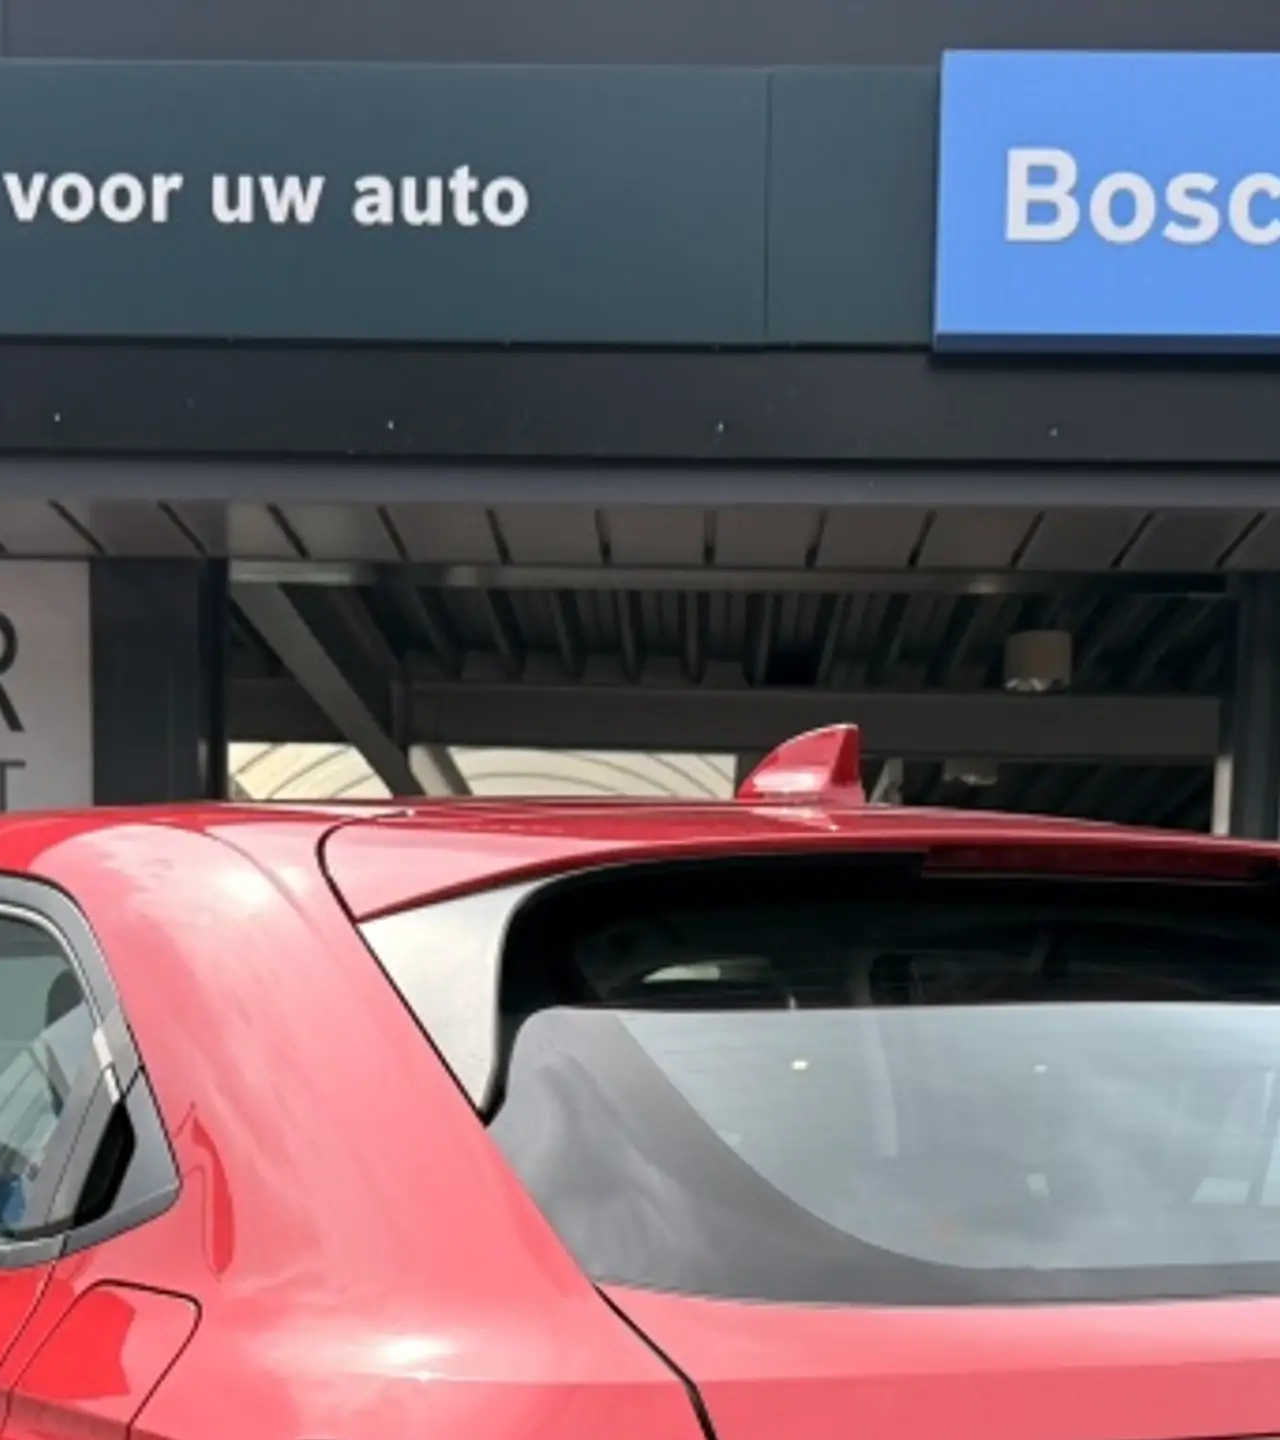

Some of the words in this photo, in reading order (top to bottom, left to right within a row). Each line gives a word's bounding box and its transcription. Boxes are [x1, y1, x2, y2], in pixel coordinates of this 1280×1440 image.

[3, 171, 184, 224] voor
[211, 174, 326, 224] uw
[352, 164, 530, 227] auto
